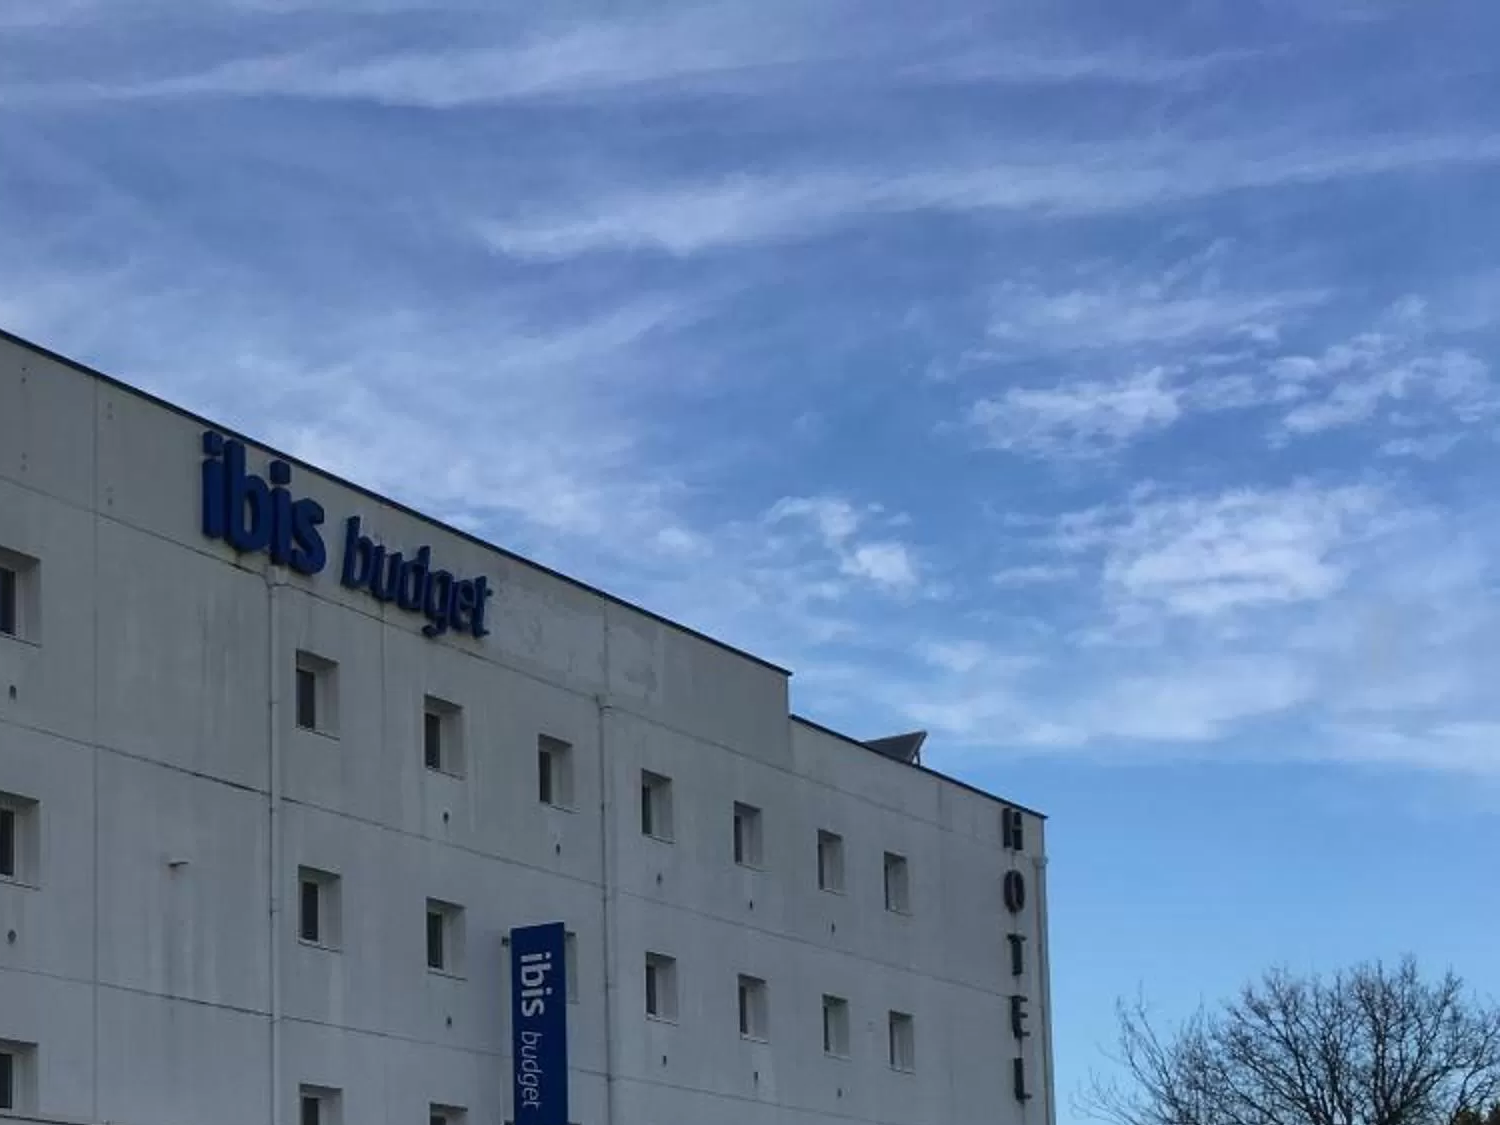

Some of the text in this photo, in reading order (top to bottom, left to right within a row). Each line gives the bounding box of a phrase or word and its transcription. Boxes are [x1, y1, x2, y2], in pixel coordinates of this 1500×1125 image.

[202, 430, 494, 640] ibis budget
[517, 951, 553, 1111] ibis budget
[1001, 807, 1032, 1104] HOTEL
